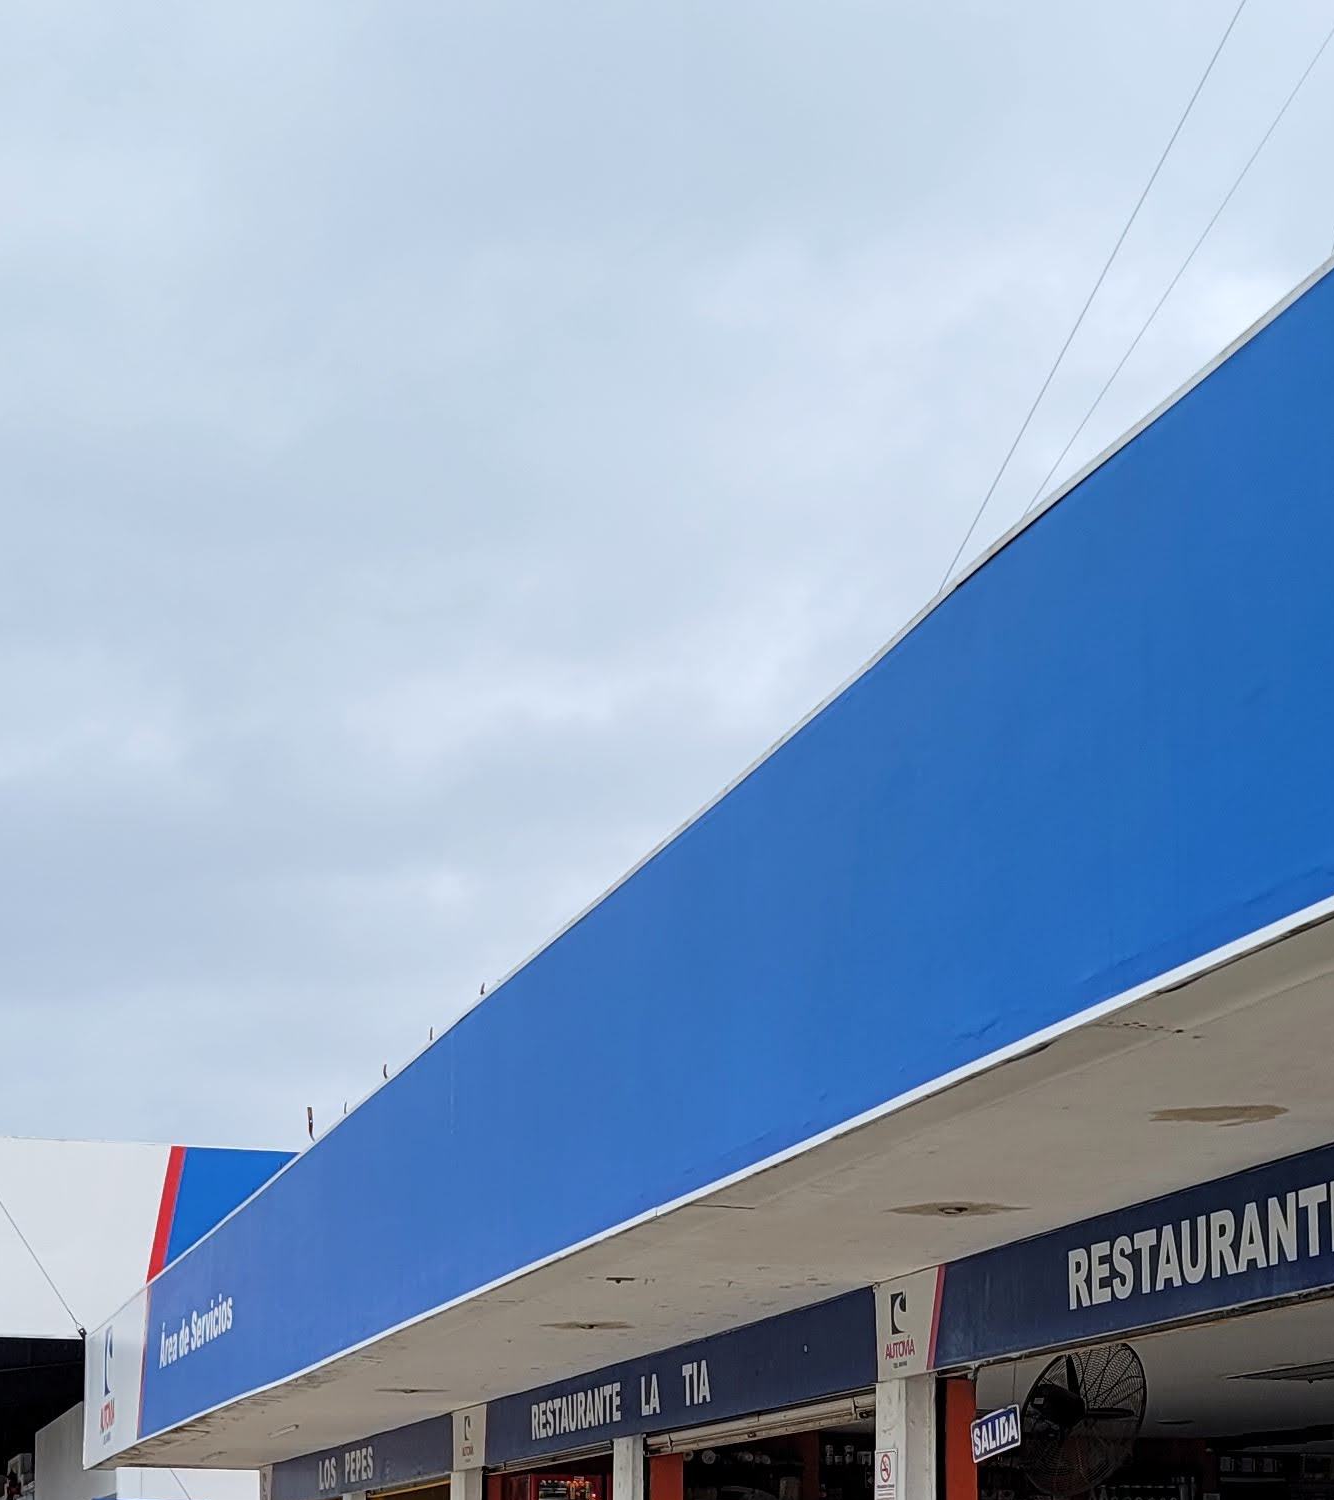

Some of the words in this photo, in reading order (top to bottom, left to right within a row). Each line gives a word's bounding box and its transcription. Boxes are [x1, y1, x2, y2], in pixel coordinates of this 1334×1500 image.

[159, 1322, 178, 1369] Área
[179, 1318, 190, 1359] de
[190, 1293, 233, 1351] Servicios
[531, 1382, 622, 1441] RESTAURANTE
[640, 1373, 661, 1417] LA
[681, 1359, 712, 1407] TIA
[973, 1412, 1018, 1456] SALIDA
[319, 1456, 337, 1490] LOS
[344, 1446, 374, 1484] PEPES
